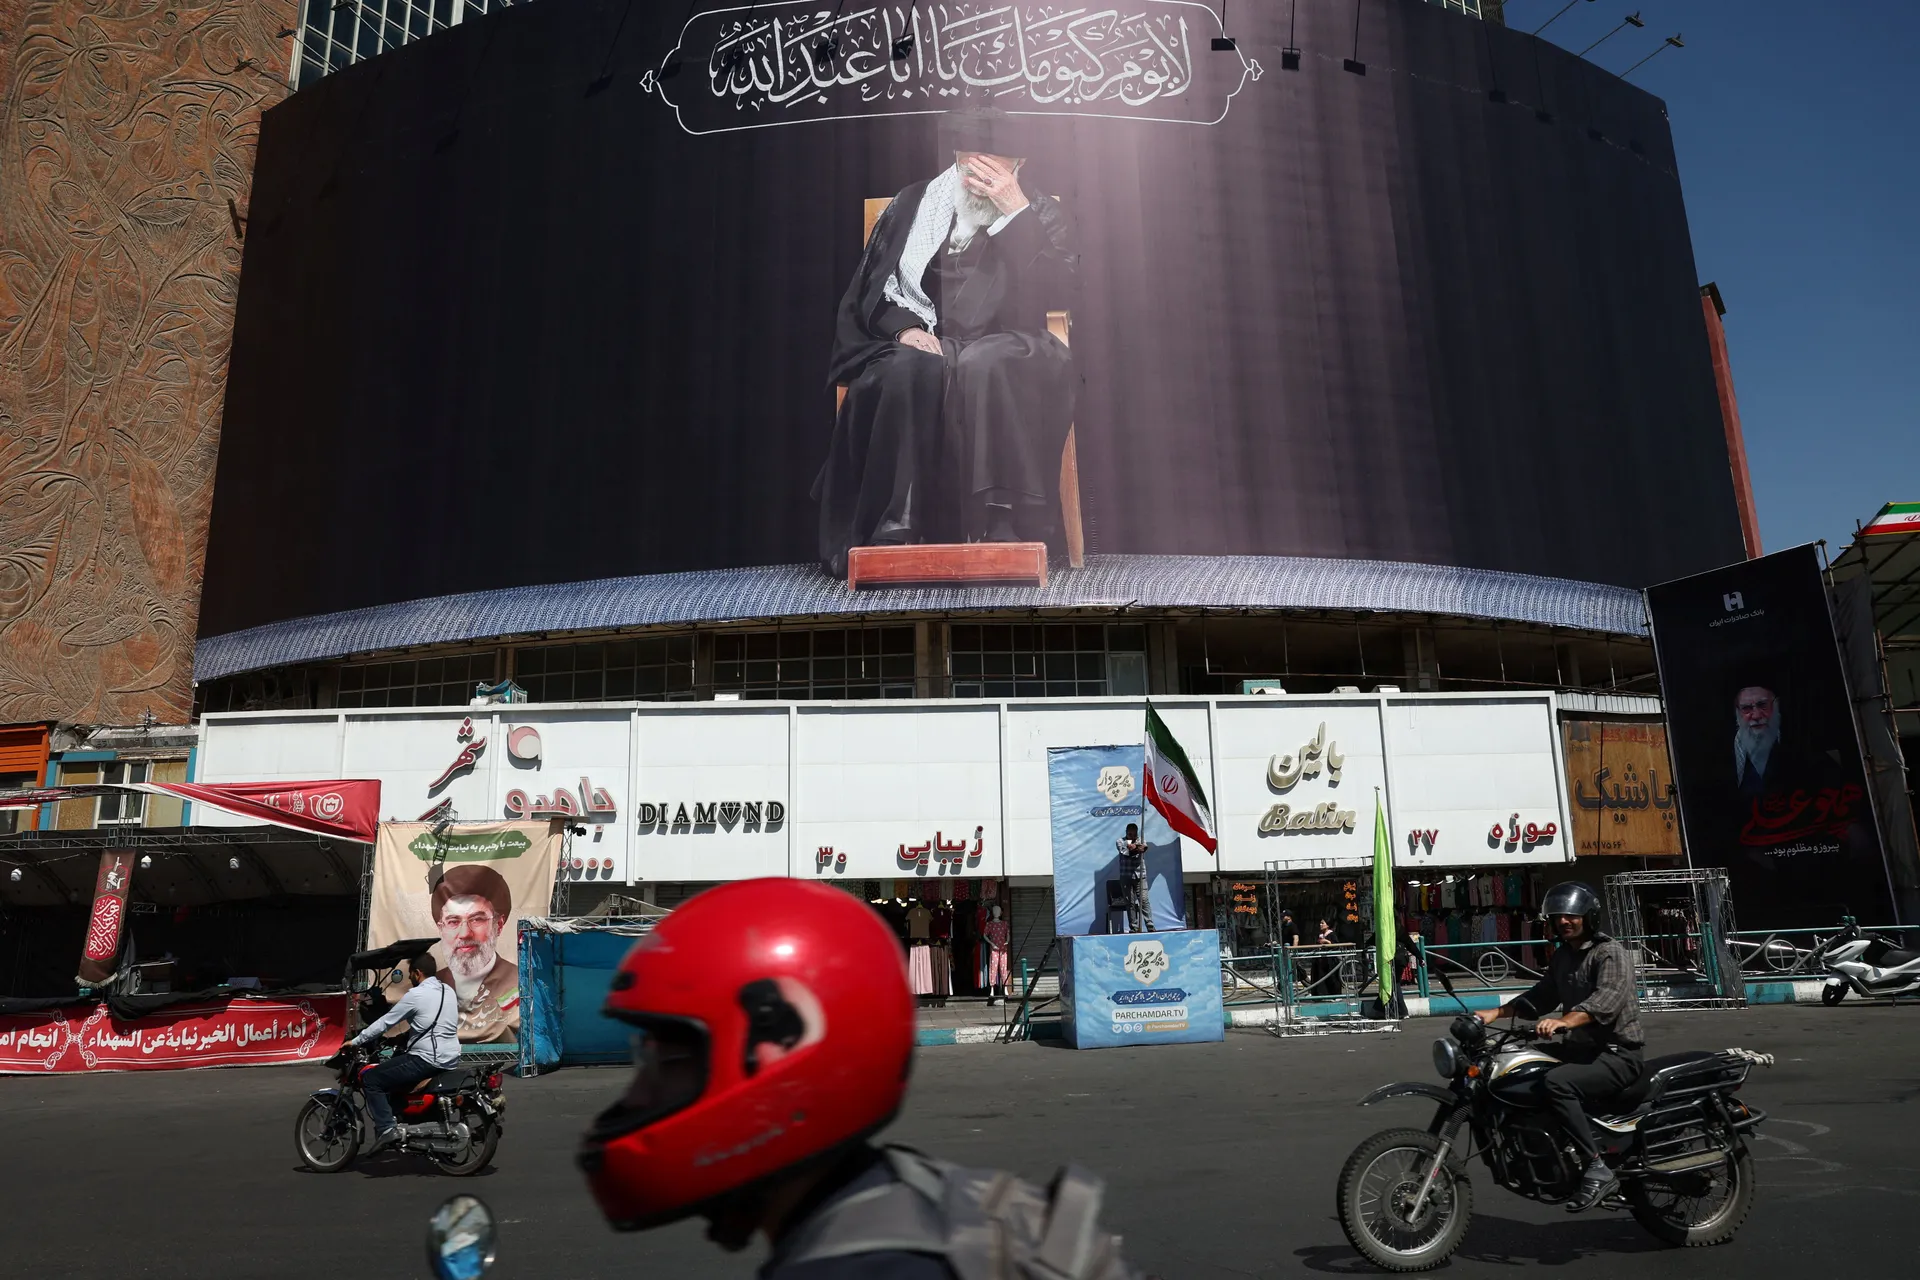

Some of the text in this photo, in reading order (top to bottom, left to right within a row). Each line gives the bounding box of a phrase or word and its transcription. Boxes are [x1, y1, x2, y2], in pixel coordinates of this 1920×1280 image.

[1259, 802, 1357, 832] Balin
[1411, 813, 1557, 846] موزه ۲۷
[818, 825, 983, 865] زیبایی ۳۰
[1787, 841, 1812, 858] مظلوم
[1819, 842, 1840, 853] پیروز
[1115, 1009, 1184, 1020] PARCHAMDAR.TV
[16, 1027, 59, 1053] انجام
[196, 1023, 235, 1050] الخير
[237, 1019, 278, 1046] أعمال
[280, 1018, 306, 1038] أداء
[142, 1036, 166, 1054] عن
